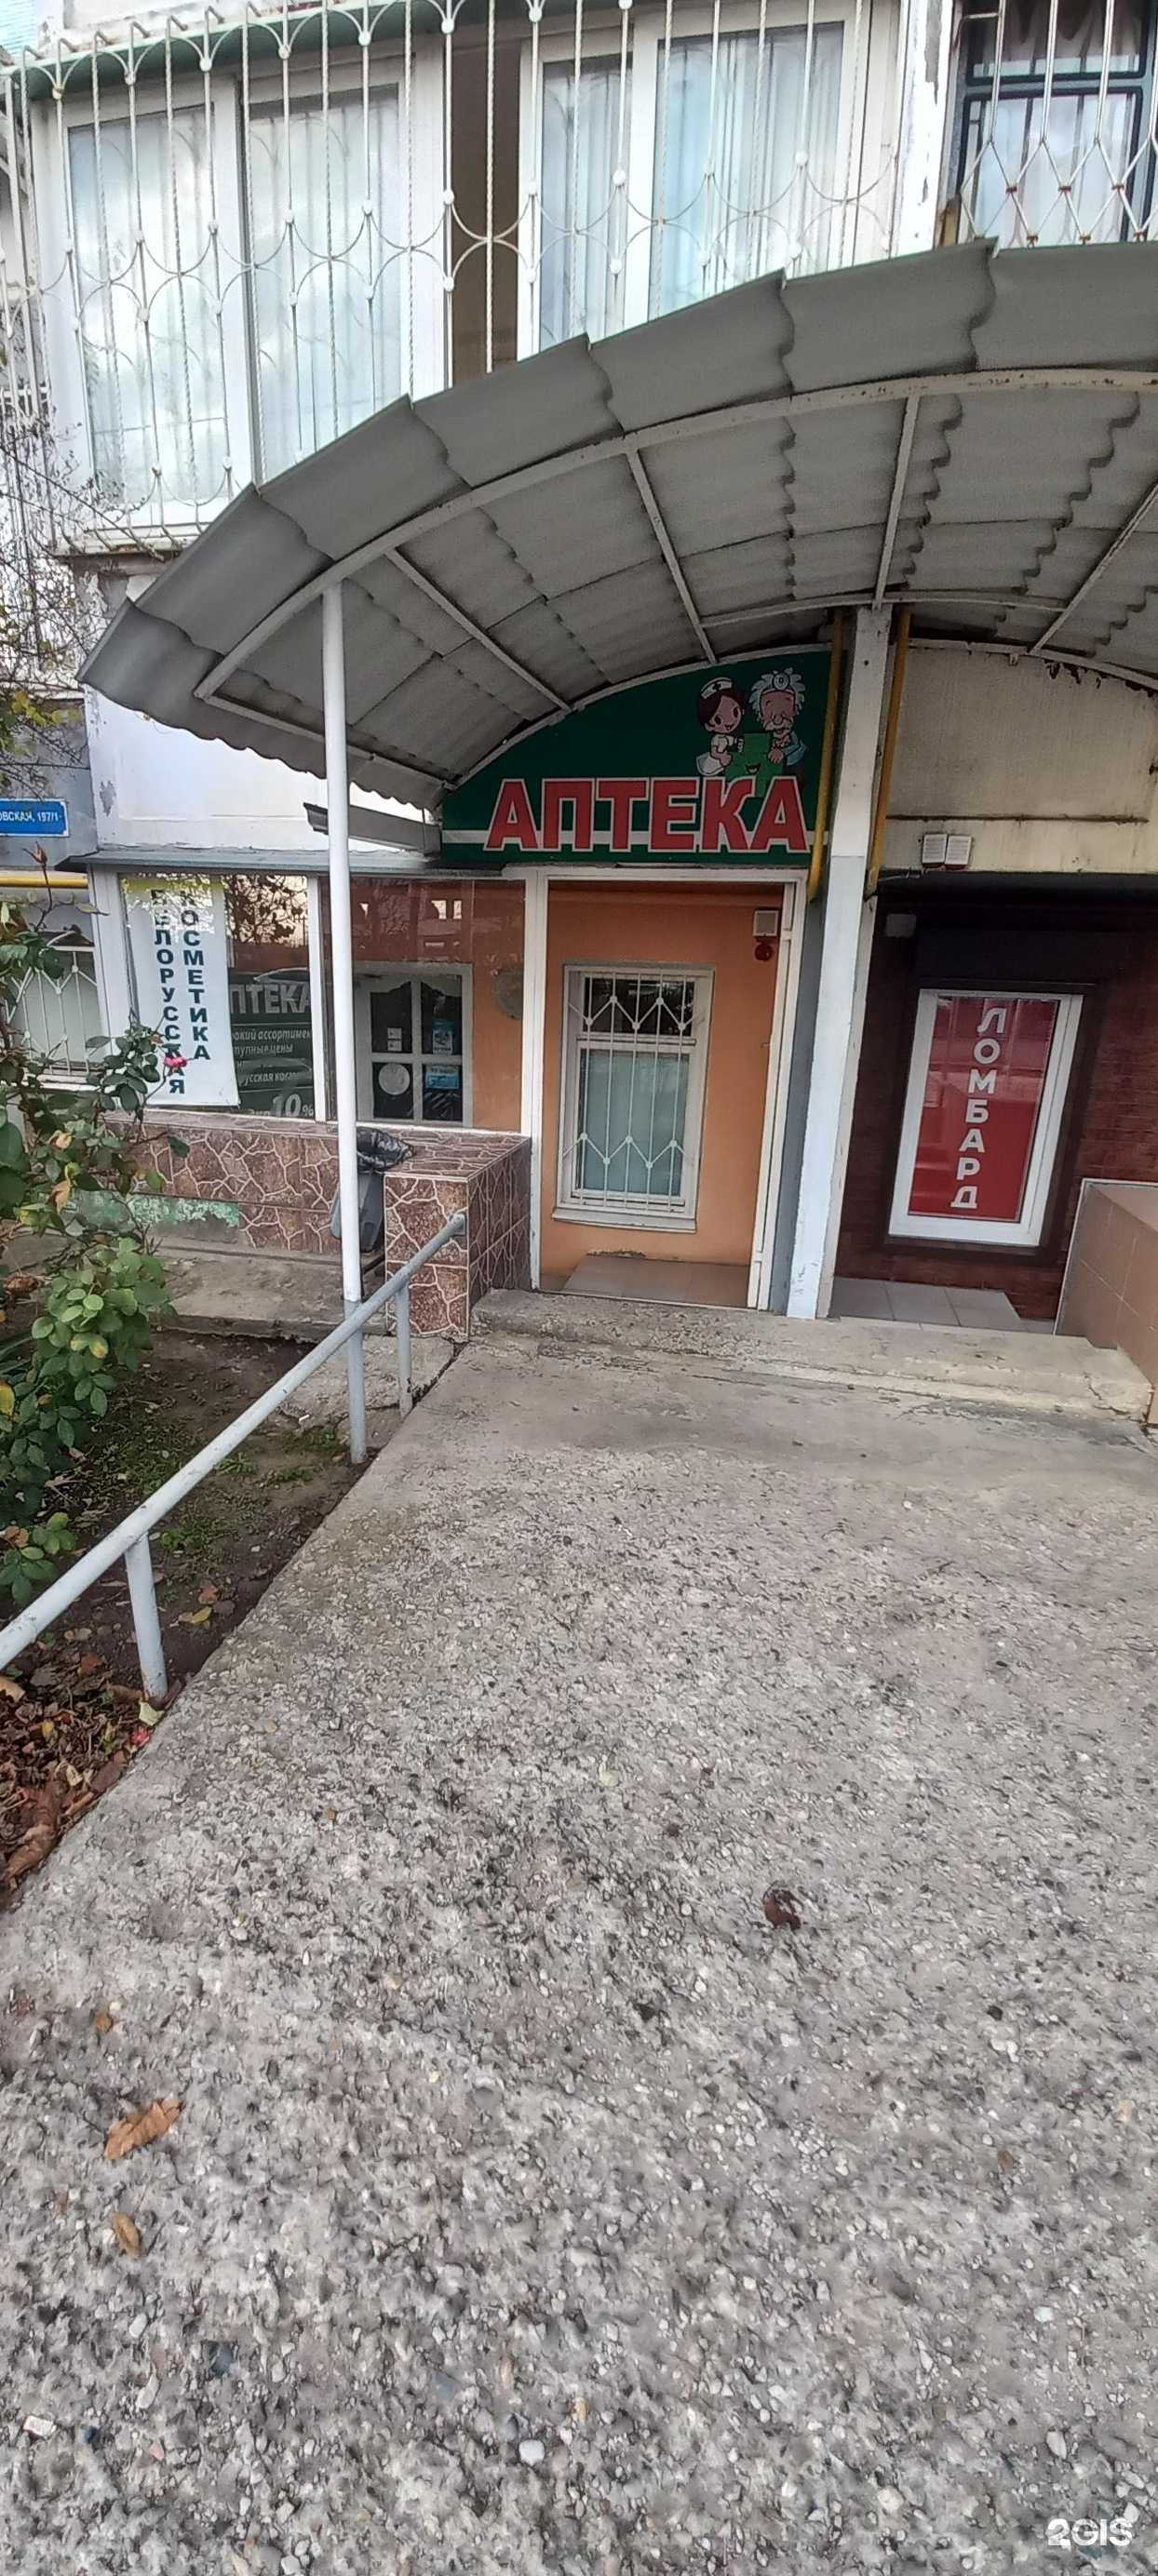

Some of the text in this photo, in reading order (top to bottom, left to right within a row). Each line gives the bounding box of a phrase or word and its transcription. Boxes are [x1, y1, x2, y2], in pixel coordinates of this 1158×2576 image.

[483, 776, 811, 853] АПТЕКА
[180, 890, 210, 1060] КОСМЕТИКА
[950, 1007, 1008, 1210] ЛОМБАРД
